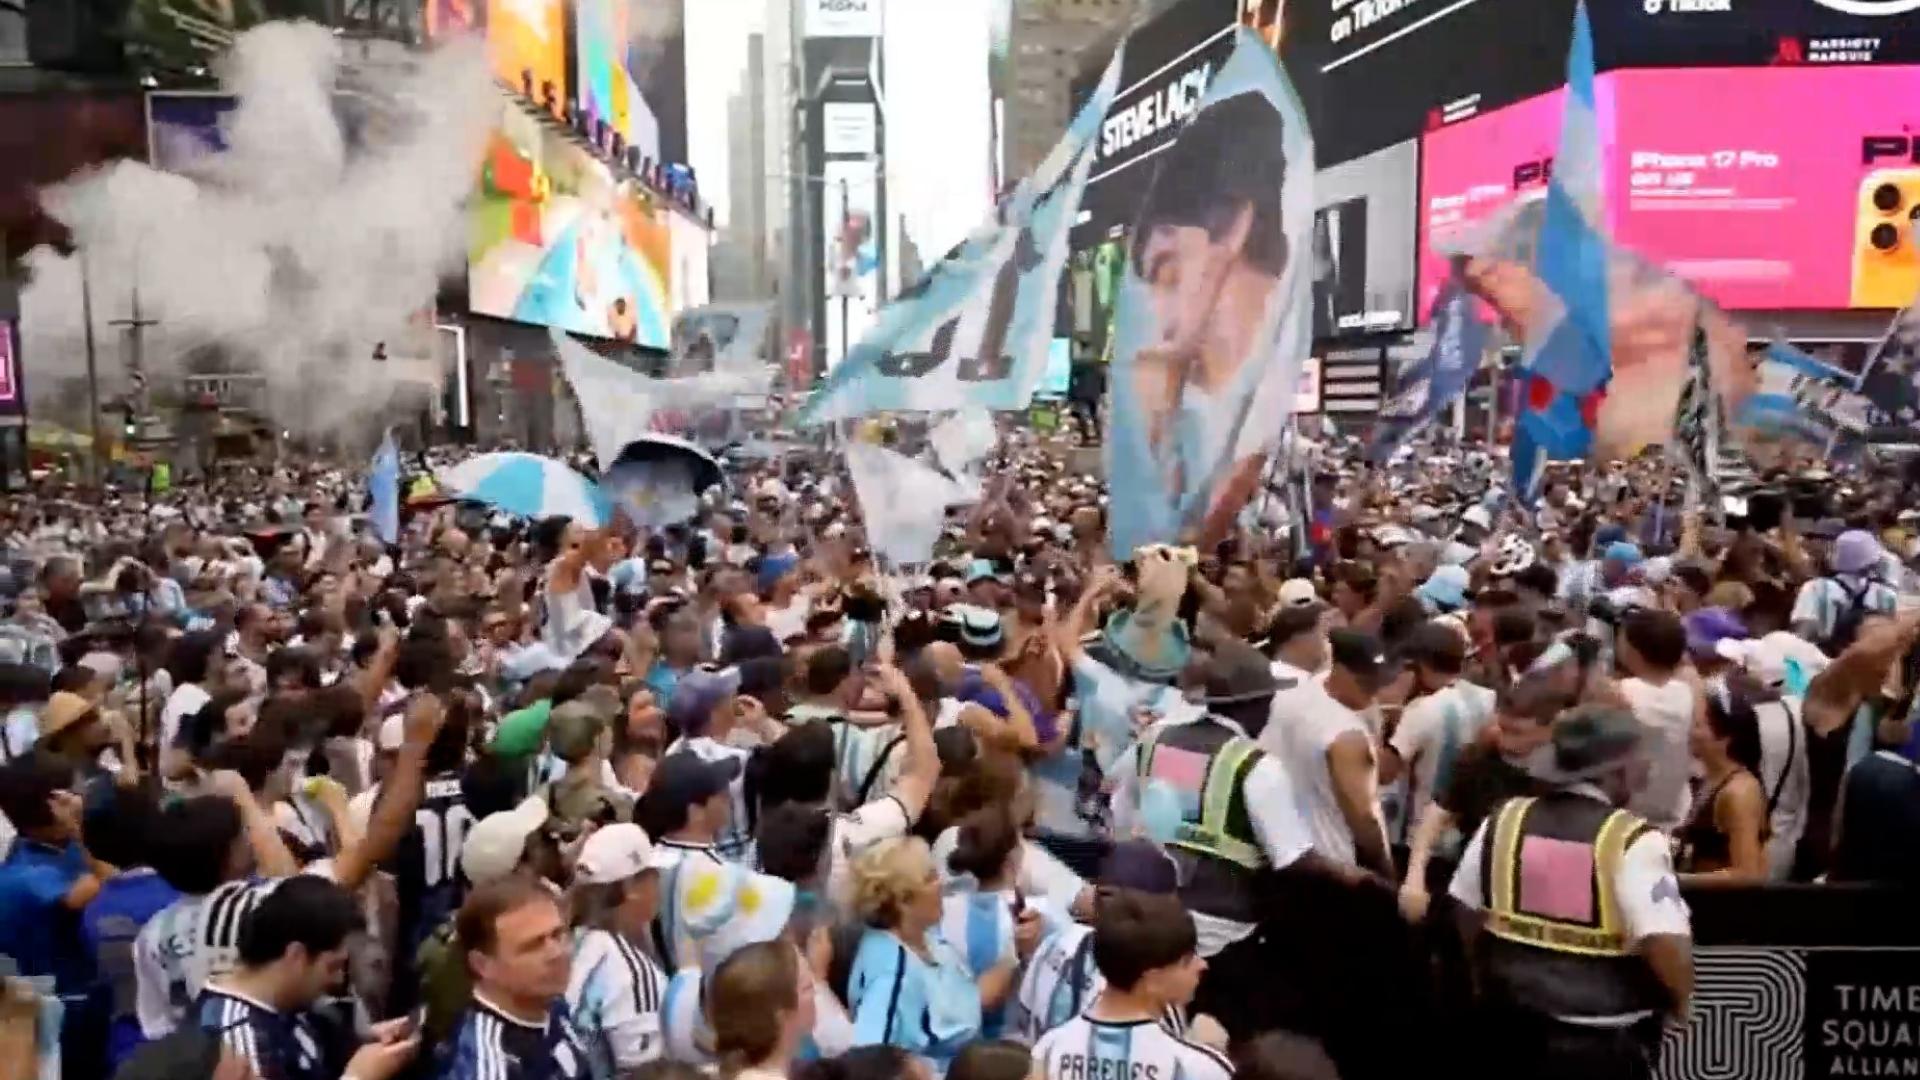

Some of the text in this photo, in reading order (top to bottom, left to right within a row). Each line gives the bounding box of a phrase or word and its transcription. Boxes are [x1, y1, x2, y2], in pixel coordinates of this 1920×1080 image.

[1103, 94, 1155, 156] STEVE
[1862, 136, 1920, 165] P
[1821, 1019, 1920, 1050] SQUA
[1060, 1053, 1160, 1080] PAREDES
